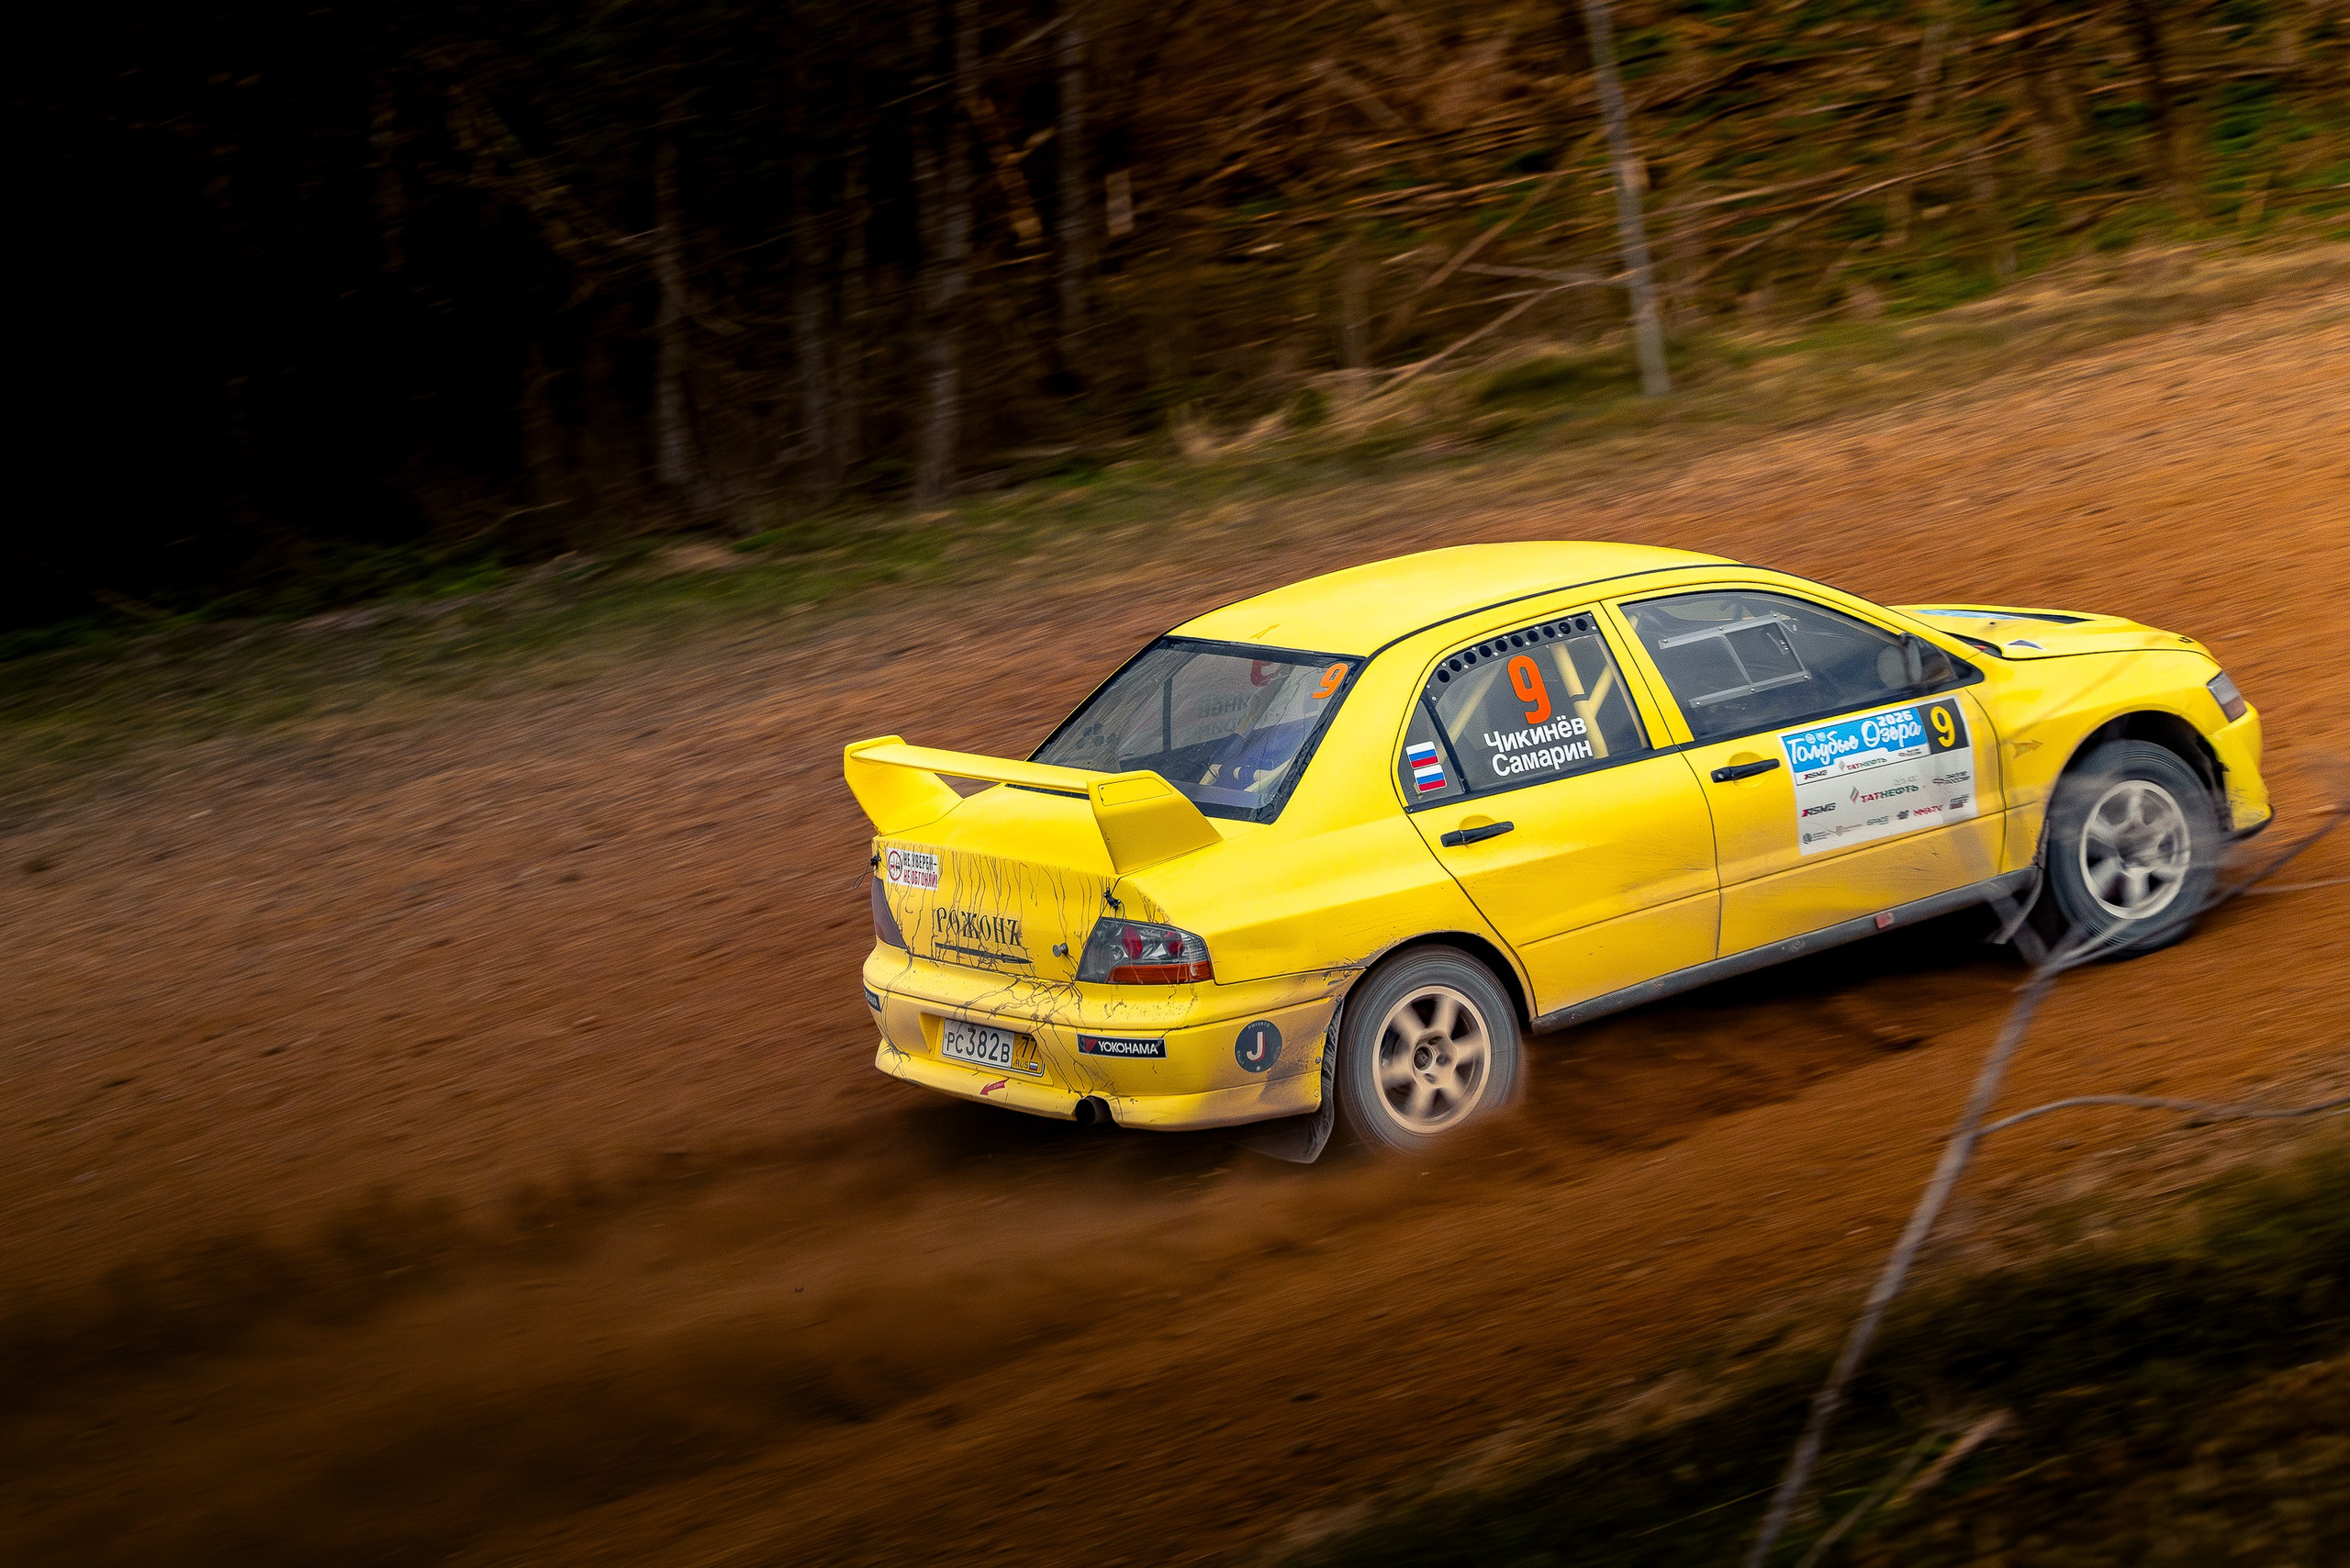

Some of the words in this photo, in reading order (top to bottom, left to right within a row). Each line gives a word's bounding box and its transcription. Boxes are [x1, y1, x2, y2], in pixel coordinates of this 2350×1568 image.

[1312, 662, 1349, 700] 9
[1507, 655, 1551, 725] 9
[1483, 715, 1587, 753] Чикинёв
[1930, 705, 1956, 748] 9
[1492, 740, 1593, 776] Самарин
[1860, 784, 1919, 803] ТАТНЕФТЬ
[902, 851, 911, 868] НЕ
[902, 868, 911, 884] НЕ
[936, 907, 1022, 946] РОЖОНЪ
[1098, 1040, 1158, 1055] YOKOHAMA
[1246, 1031, 1266, 1062] J
